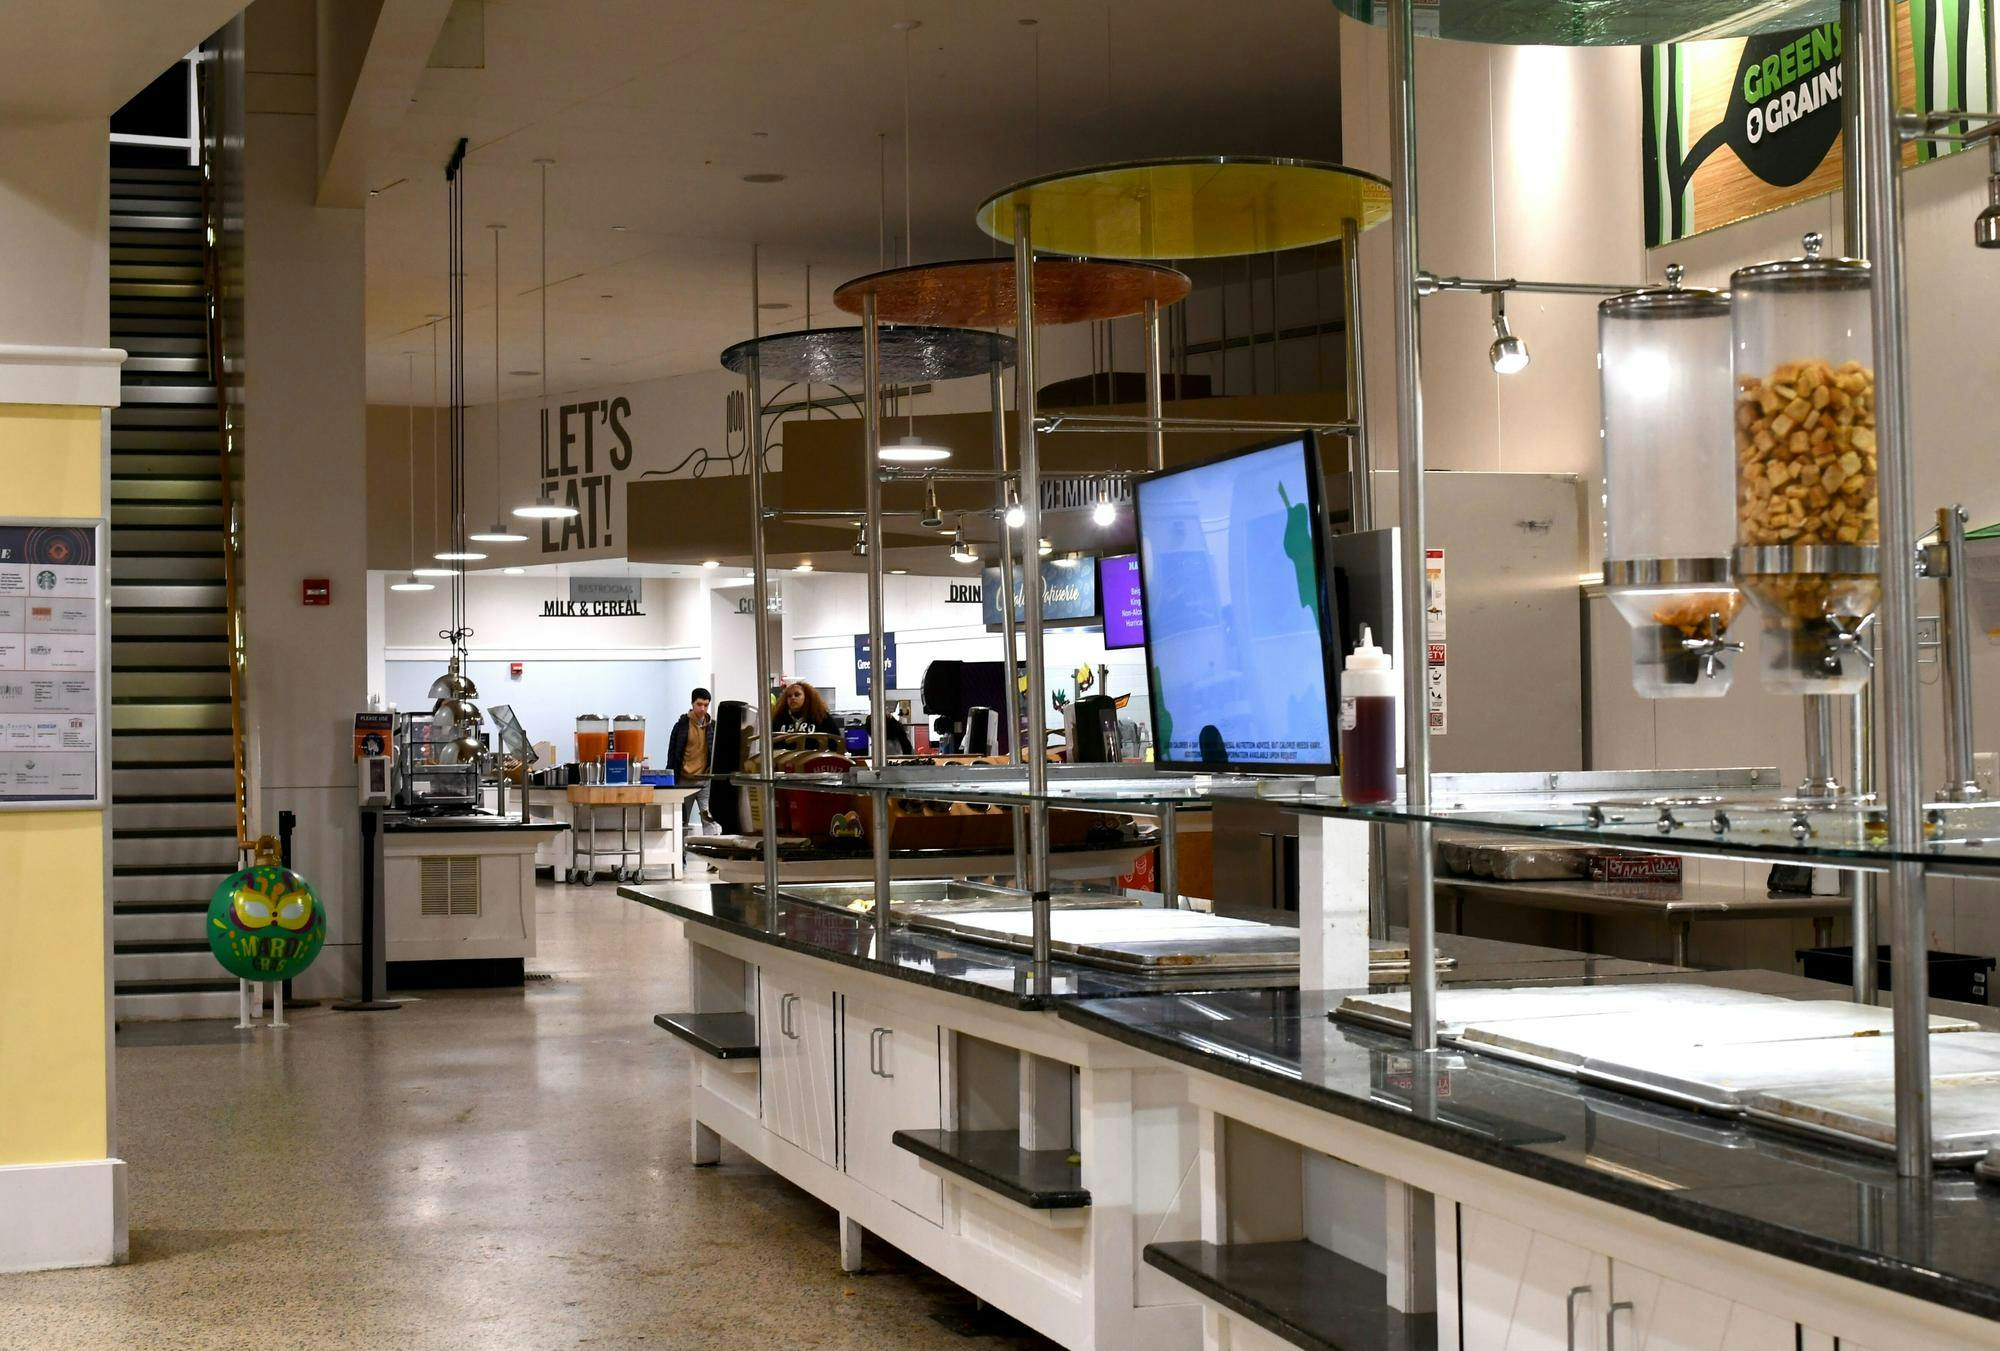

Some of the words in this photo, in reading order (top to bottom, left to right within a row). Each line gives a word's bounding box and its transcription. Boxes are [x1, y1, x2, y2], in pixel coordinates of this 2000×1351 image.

[1744, 22, 1841, 104] GREENS
[541, 397, 632, 482] LET'S
[541, 475, 612, 553] EAT!
[544, 601, 576, 616] MILK
[579, 602, 589, 616] &
[593, 600, 640, 616] CEREAL
[950, 585, 981, 601] DRIN
